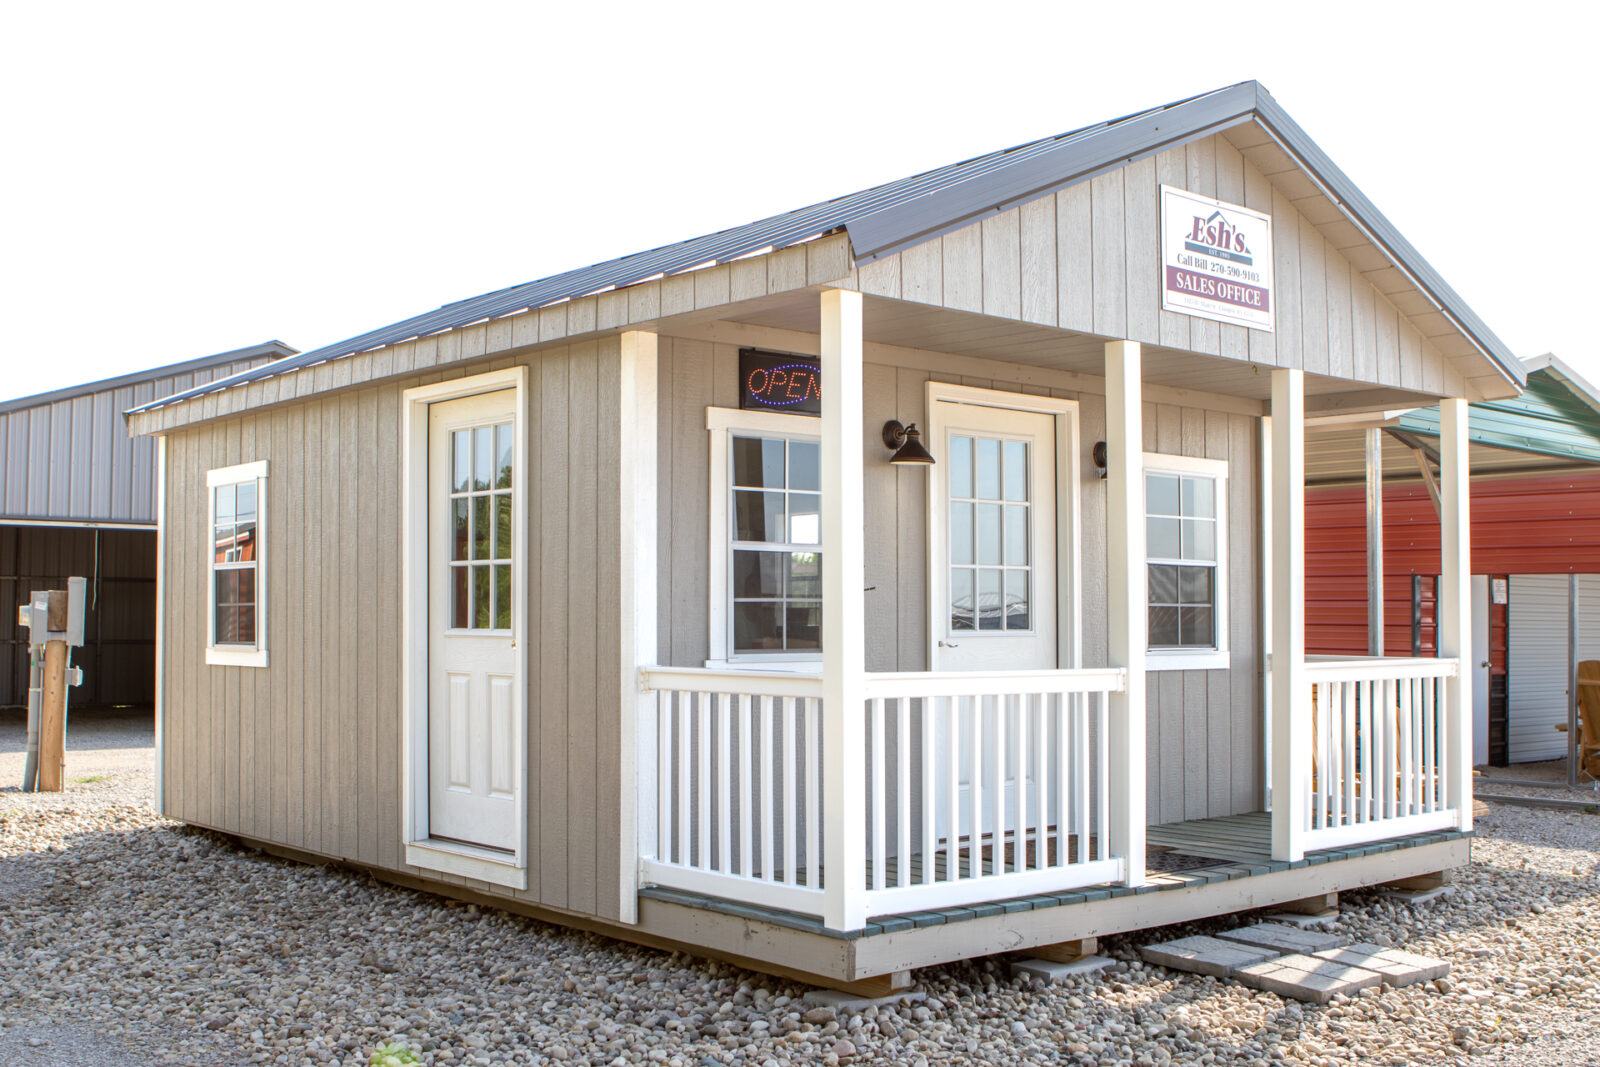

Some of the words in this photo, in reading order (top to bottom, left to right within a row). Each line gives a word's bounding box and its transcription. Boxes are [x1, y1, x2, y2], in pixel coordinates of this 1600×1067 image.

[1192, 216, 1245, 253] Esh's
[1177, 253, 1193, 266] Call
[1194, 257, 1208, 270] Bill
[1210, 262, 1260, 282] 270-590-9103
[1176, 272, 1215, 296] SALES
[1217, 282, 1261, 306] OFFICE
[748, 368, 822, 400] OPEN
